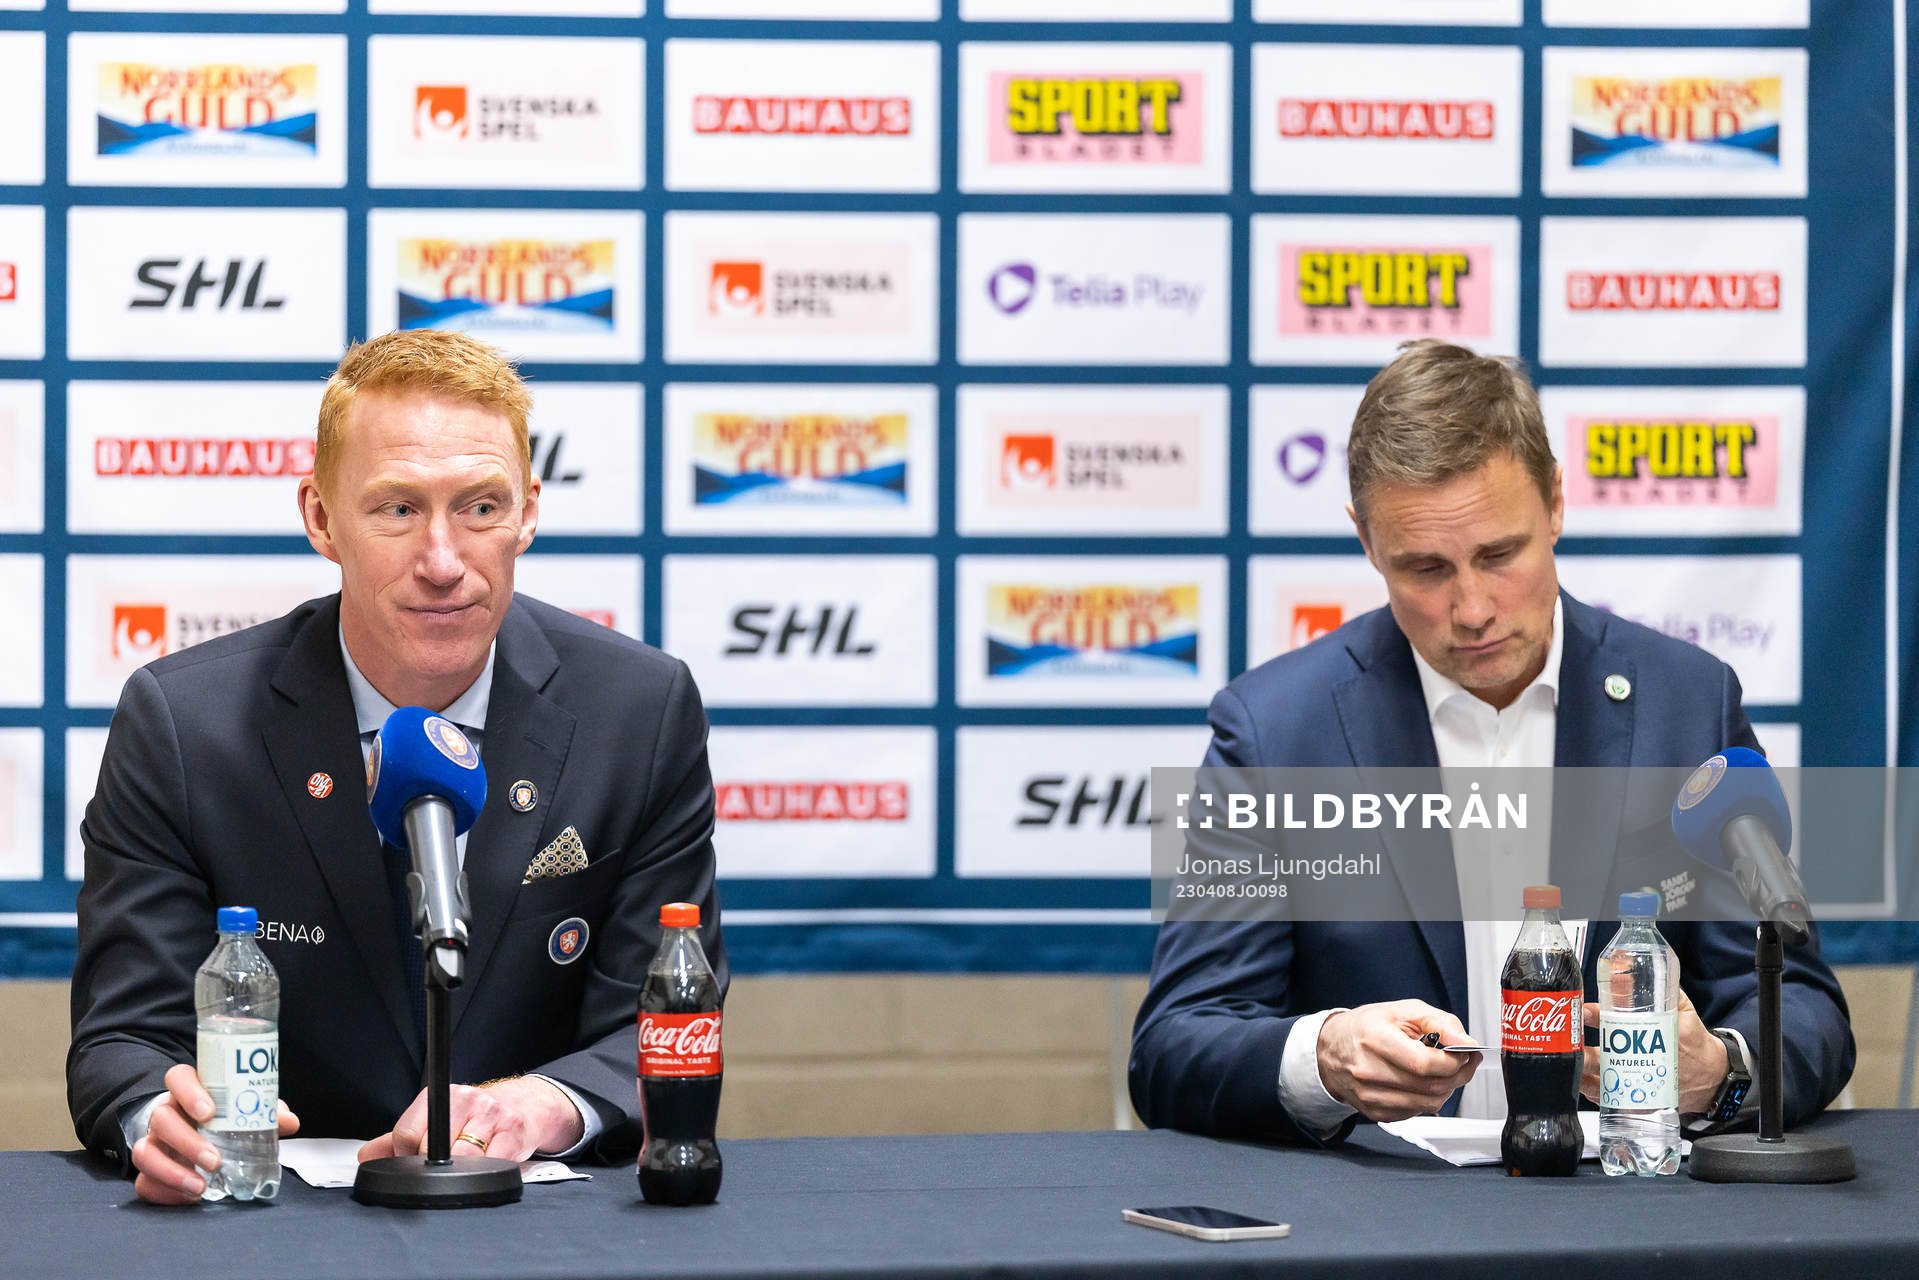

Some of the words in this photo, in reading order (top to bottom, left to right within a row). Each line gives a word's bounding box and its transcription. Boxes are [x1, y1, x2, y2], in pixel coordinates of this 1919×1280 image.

[119, 65, 297, 99] NORRLANDS
[1593, 78, 1762, 111] NORRLANDS
[144, 97, 276, 130] GULD
[479, 96, 600, 116] SVENSKA
[695, 97, 910, 134] BAUHAUS
[1008, 79, 1182, 137] SPORT
[1279, 100, 1495, 138] BAUHAUS
[479, 120, 540, 140] SPEL
[1614, 108, 1741, 143] GULD
[1016, 142, 1175, 160] BLADET
[420, 241, 597, 274] NORRLANDS
[128, 258, 286, 311] SHL
[442, 272, 574, 305] GULD
[774, 272, 893, 292] SVENSKA
[1050, 275, 1125, 308] Telia
[1136, 275, 1202, 314] Play
[1297, 249, 1469, 308] SPORT
[1567, 273, 1779, 310] BAUHAUS
[774, 297, 833, 317] SPEL
[714, 416, 887, 447] NORRLANDS
[95, 439, 315, 477] BAUHAUS
[737, 444, 868, 480] GULD
[1066, 445, 1184, 464] SVENSKA
[1585, 423, 1757, 480] SPORT
[1066, 470, 1125, 489] SPEL
[1008, 588, 1179, 620] NORRLANDS
[724, 606, 876, 657] SHL
[1029, 614, 1160, 650] GULD
[1708, 604, 1776, 654] Play
[716, 782, 908, 820] AUHAUS
[1017, 776, 1164, 825] SHL
[1603, 1028, 1666, 1054] LOKA
[236, 1048, 278, 1073] LOK
[1609, 1058, 1656, 1066] NATURELL
